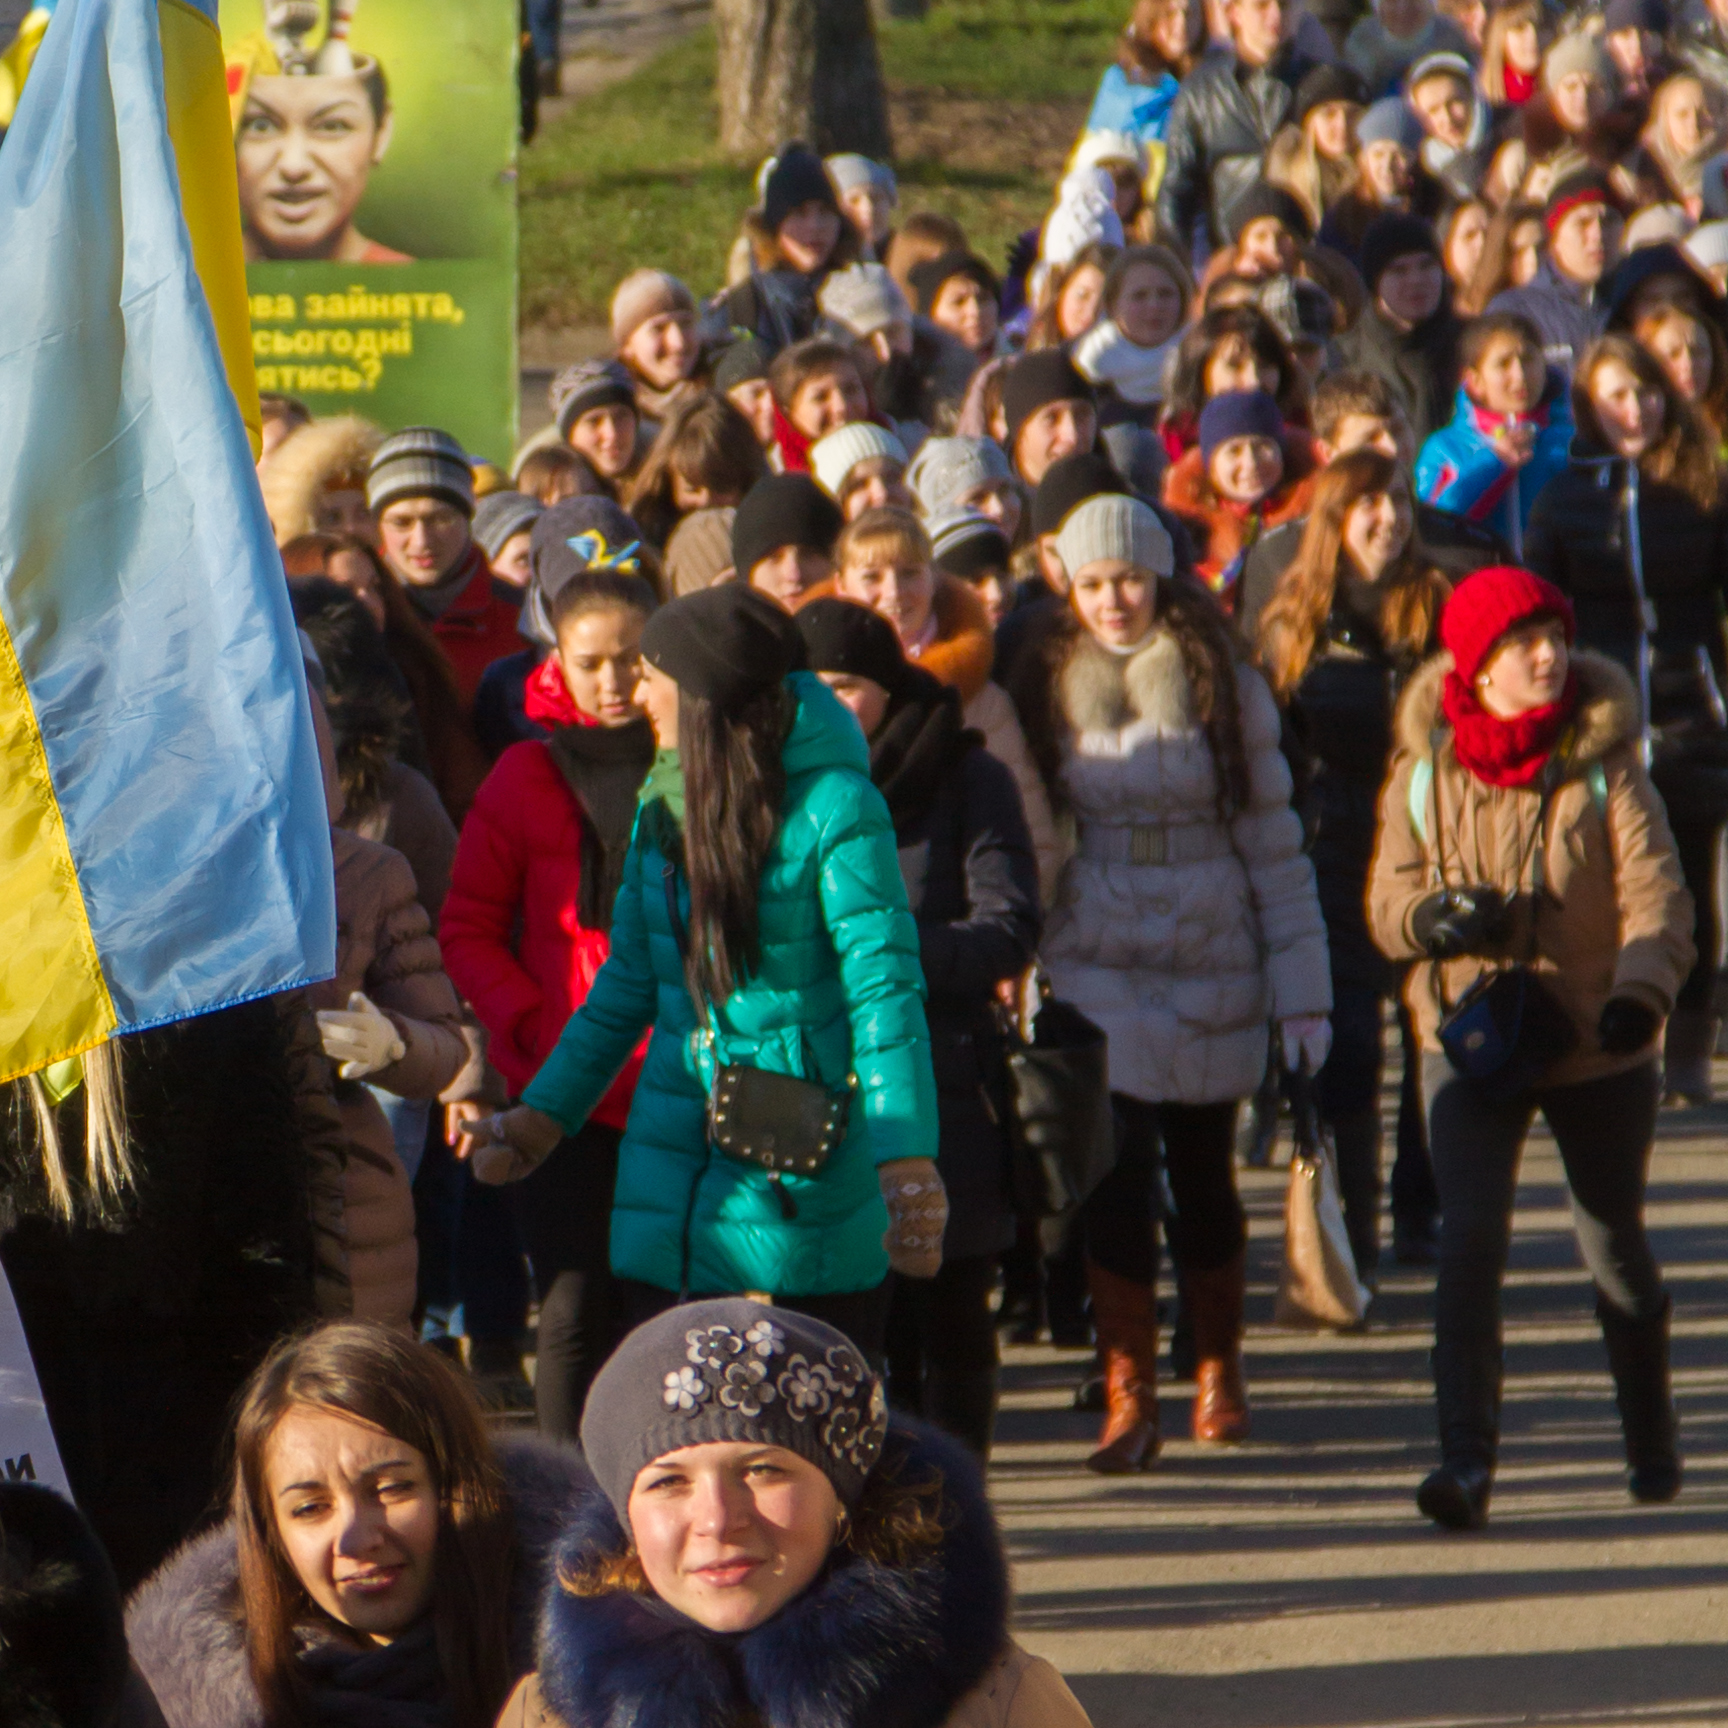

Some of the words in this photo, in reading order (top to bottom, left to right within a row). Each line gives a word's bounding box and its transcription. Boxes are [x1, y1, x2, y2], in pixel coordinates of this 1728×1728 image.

[249, 292, 297, 321] ва
[305, 283, 466, 327] зайнята,
[252, 320, 413, 362] сьогодні
